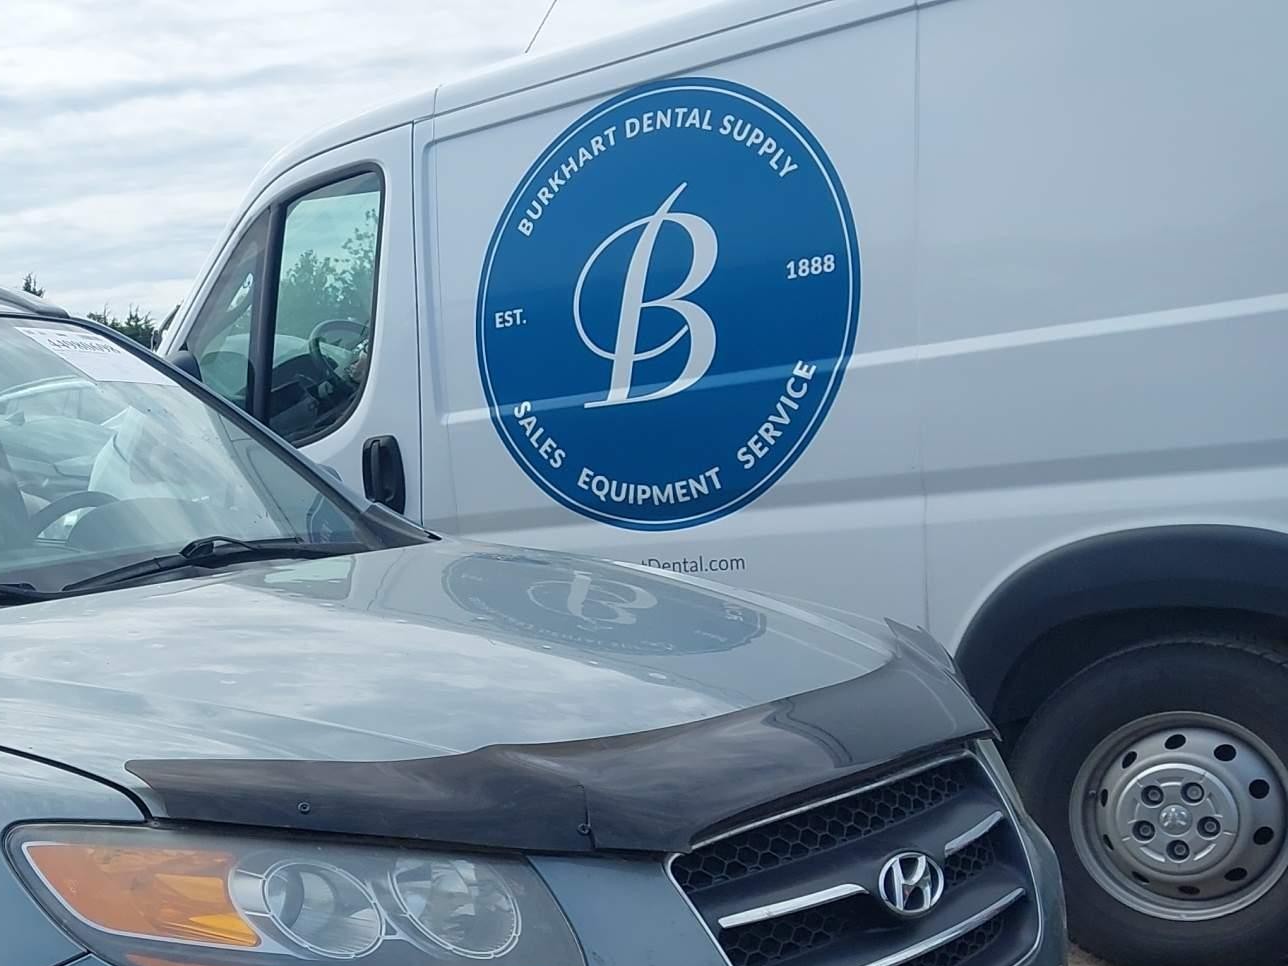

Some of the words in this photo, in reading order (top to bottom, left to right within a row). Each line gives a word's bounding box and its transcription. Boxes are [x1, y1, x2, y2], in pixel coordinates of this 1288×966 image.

[518, 127, 617, 237] BURKHART
[625, 107, 713, 139] DENTAL
[718, 114, 799, 178] SUPPLY
[495, 309, 527, 328] EST.
[786, 254, 836, 279] 1888
[514, 400, 566, 469] SALES
[576, 467, 724, 506] EQUIPMENT
[736, 360, 817, 470] SERVICE
